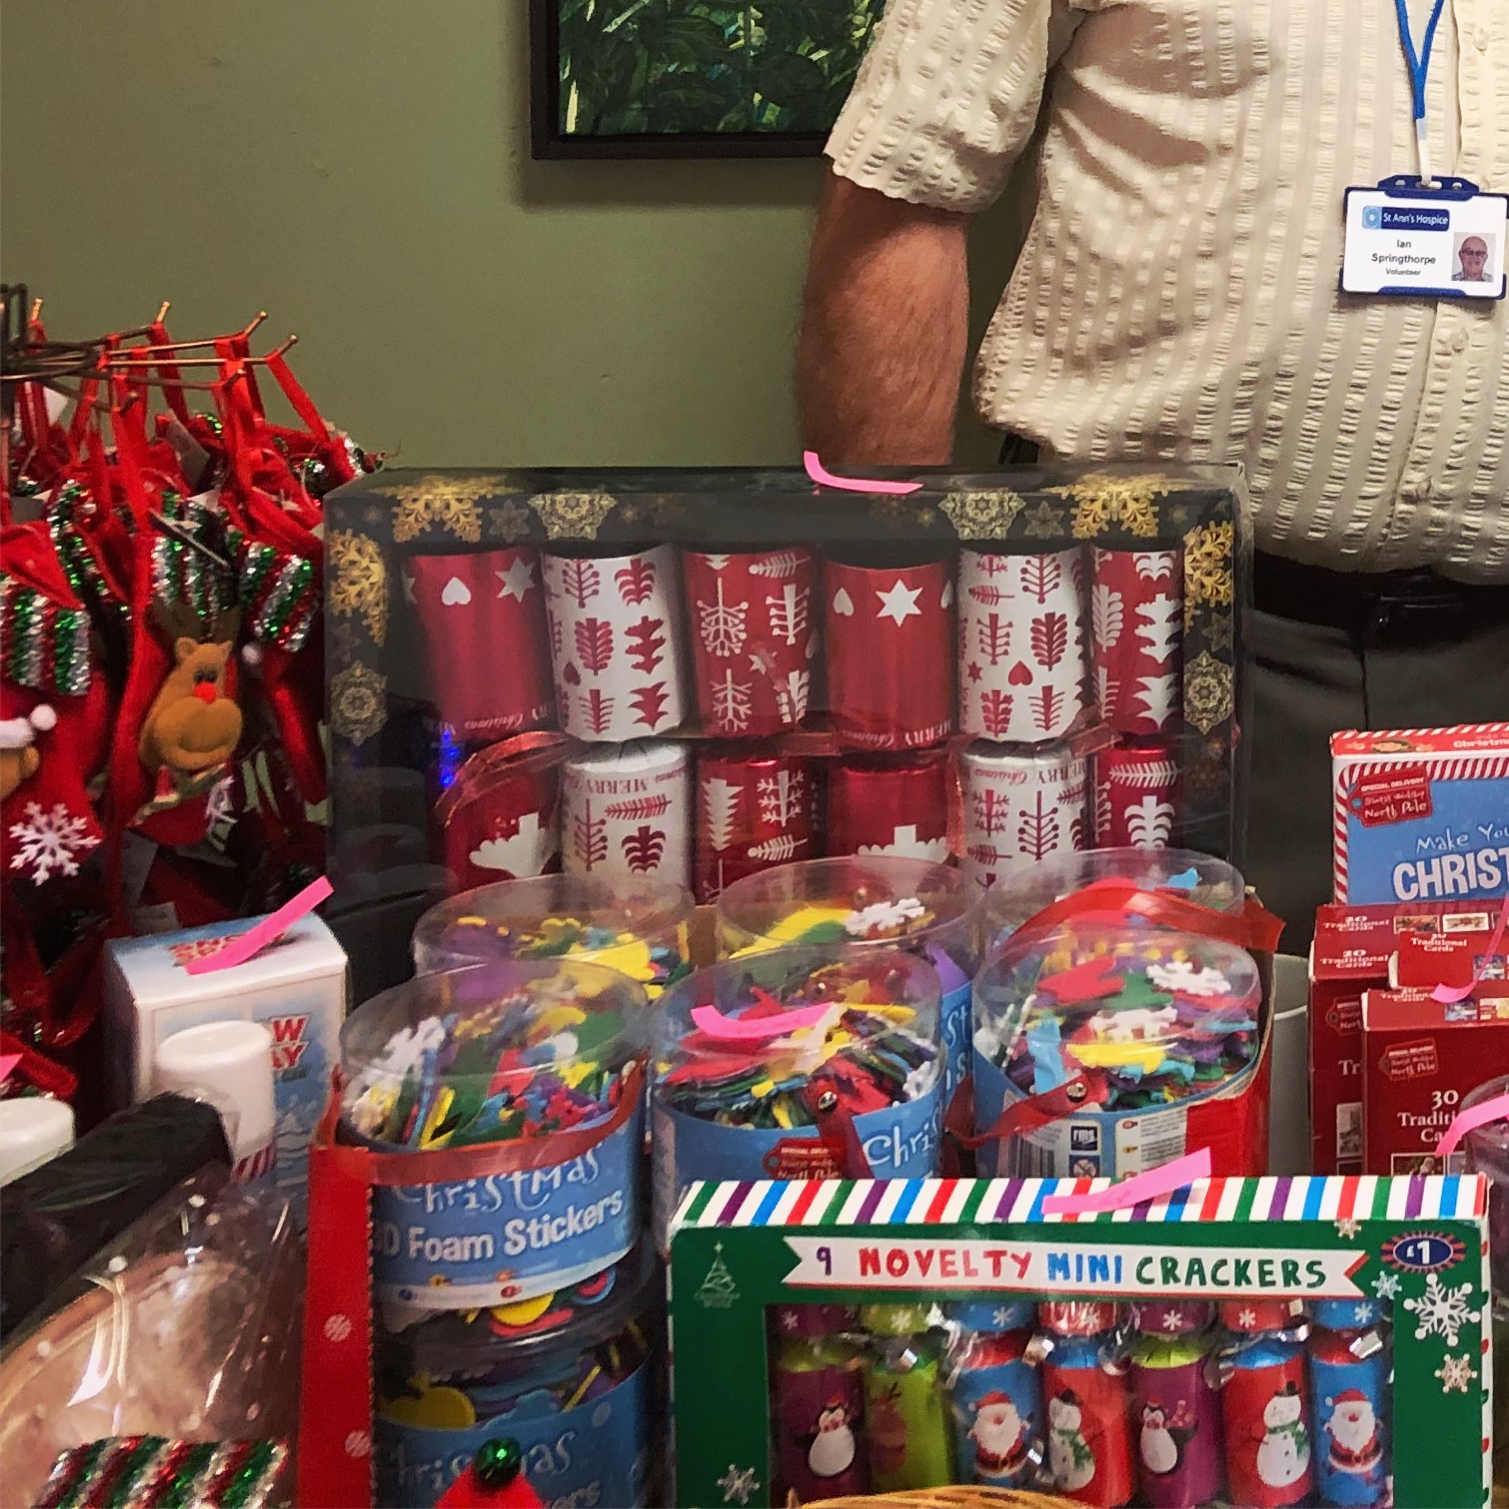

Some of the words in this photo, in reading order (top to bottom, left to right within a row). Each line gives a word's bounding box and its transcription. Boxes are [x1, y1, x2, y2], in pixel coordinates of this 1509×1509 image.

[1383, 213, 1391, 222] St
[1393, 214, 1415, 224] Ann's
[1416, 215, 1448, 226] Hospice
[1396, 239, 1412, 248] Ian
[1371, 253, 1436, 268] Springthorpe
[1364, 802, 1398, 819] North
[1401, 799, 1428, 813] Pole
[1415, 827, 1470, 854] Make
[1431, 1089, 1459, 1111] 30
[1396, 1111, 1457, 1127] Traditi
[408, 1225, 494, 1262] Foam
[503, 1190, 624, 1257] Stickers
[1406, 1239, 1430, 1265] £1
[816, 1247, 833, 1277] 9
[858, 1247, 1033, 1280] NOVELTY
[1047, 1252, 1122, 1283] MINI
[1135, 1256, 1327, 1290] CRACKERS
